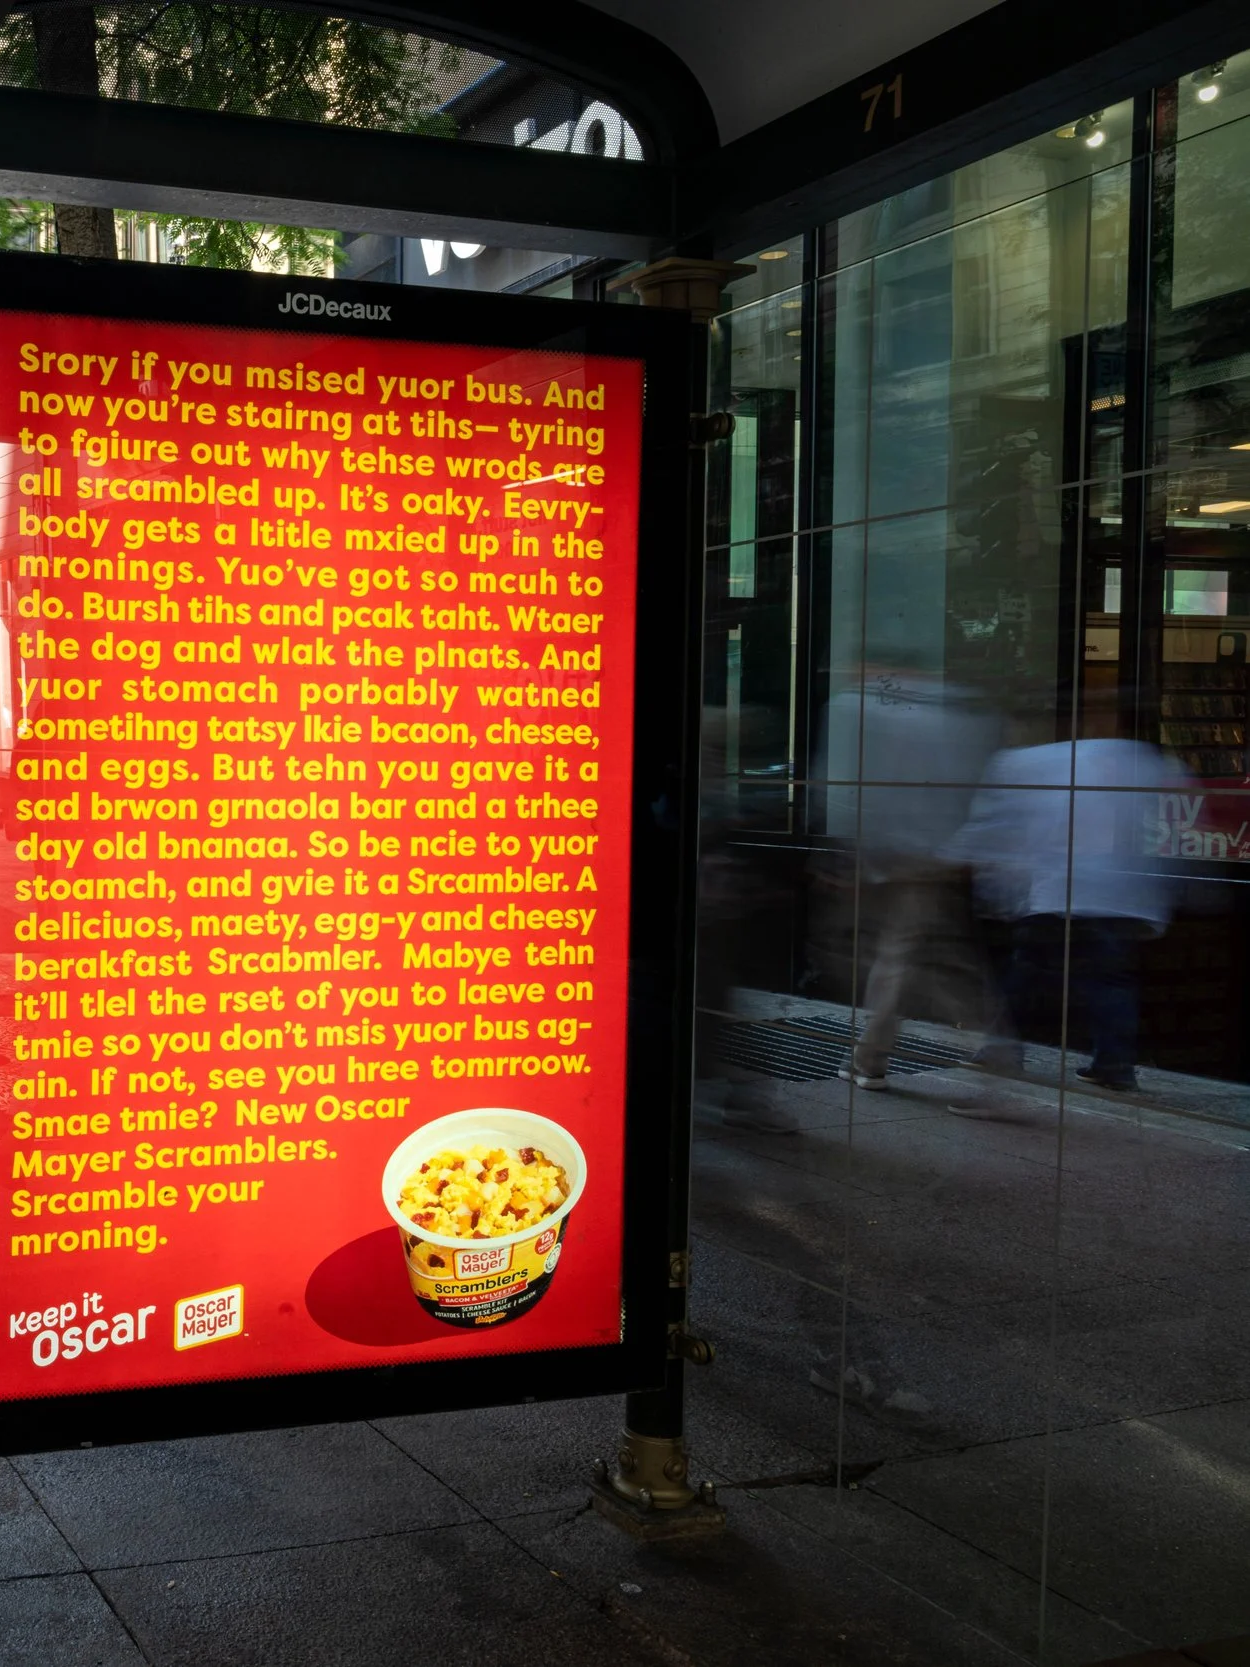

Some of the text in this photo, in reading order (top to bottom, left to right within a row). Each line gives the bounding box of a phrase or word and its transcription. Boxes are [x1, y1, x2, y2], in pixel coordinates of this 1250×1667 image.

[861, 73, 903, 132] 71
[278, 292, 392, 321] JCDecaux
[20, 344, 604, 409] Srory if you msised yuor bus. And
[21, 392, 94, 416] now
[104, 395, 216, 426] you’re
[227, 402, 351, 440] stairng
[363, 411, 401, 435] at
[509, 419, 603, 455] tyring
[19, 428, 57, 455] to
[71, 429, 178, 467] fgiure
[191, 441, 250, 466] out
[262, 441, 330, 478] why
[341, 446, 434, 476] tehse
[446, 454, 542, 482] wrods
[19, 468, 603, 528] all srcambled up. It’s oaky. Eevry-
[19, 552, 602, 597] mronings. Yuo’ve got so mcuh to
[18, 589, 604, 634] do. Bursh tihs and pcak taht. Wtaer
[18, 630, 600, 675] the dog and wlak the plnats. And
[17, 675, 599, 713] yuor stomach porbably watned
[17, 713, 199, 749] sometihng
[207, 716, 296, 750] tatsy
[371, 715, 477, 748] bcaon,
[486, 717, 599, 749] chesee,
[16, 752, 598, 789] and eggs. But tehn you gave it a
[16, 792, 598, 828] sad brwon grnaola bar and a trhee
[16, 830, 598, 868] day old bnanaa. So be ncie to yuor
[15, 866, 597, 904] stoamch, and gvie it a Srcambler. A
[15, 904, 596, 942] deliciuos, maety, egg-y and cheesy
[15, 939, 593, 981] berakfast Srcabmler. Mabye tehn
[13, 1014, 591, 1061] tmie so you don’t msis yuor bus ag-
[13, 1055, 590, 1100] ain. If not, see you hree tomrroow.
[13, 1095, 410, 1139] Smae tmie? New Oscar
[13, 1135, 337, 1182] Mayer Scramblers.
[12, 1180, 264, 1217] Srcamble your
[461, 1257, 505, 1274] Mayer
[462, 1248, 504, 1264] Oscar
[435, 1268, 528, 1294] Scramblers
[9, 1291, 104, 1339] Keep it
[181, 1310, 237, 1339] Mayer
[184, 1294, 235, 1320] Oscar
[461, 1301, 496, 1313] SCRAMBLE
[496, 1298, 508, 1306] KIT
[467, 1310, 491, 1318] CHEESE
[491, 1303, 512, 1313] SAUCE
[32, 1305, 157, 1367] Oscar
